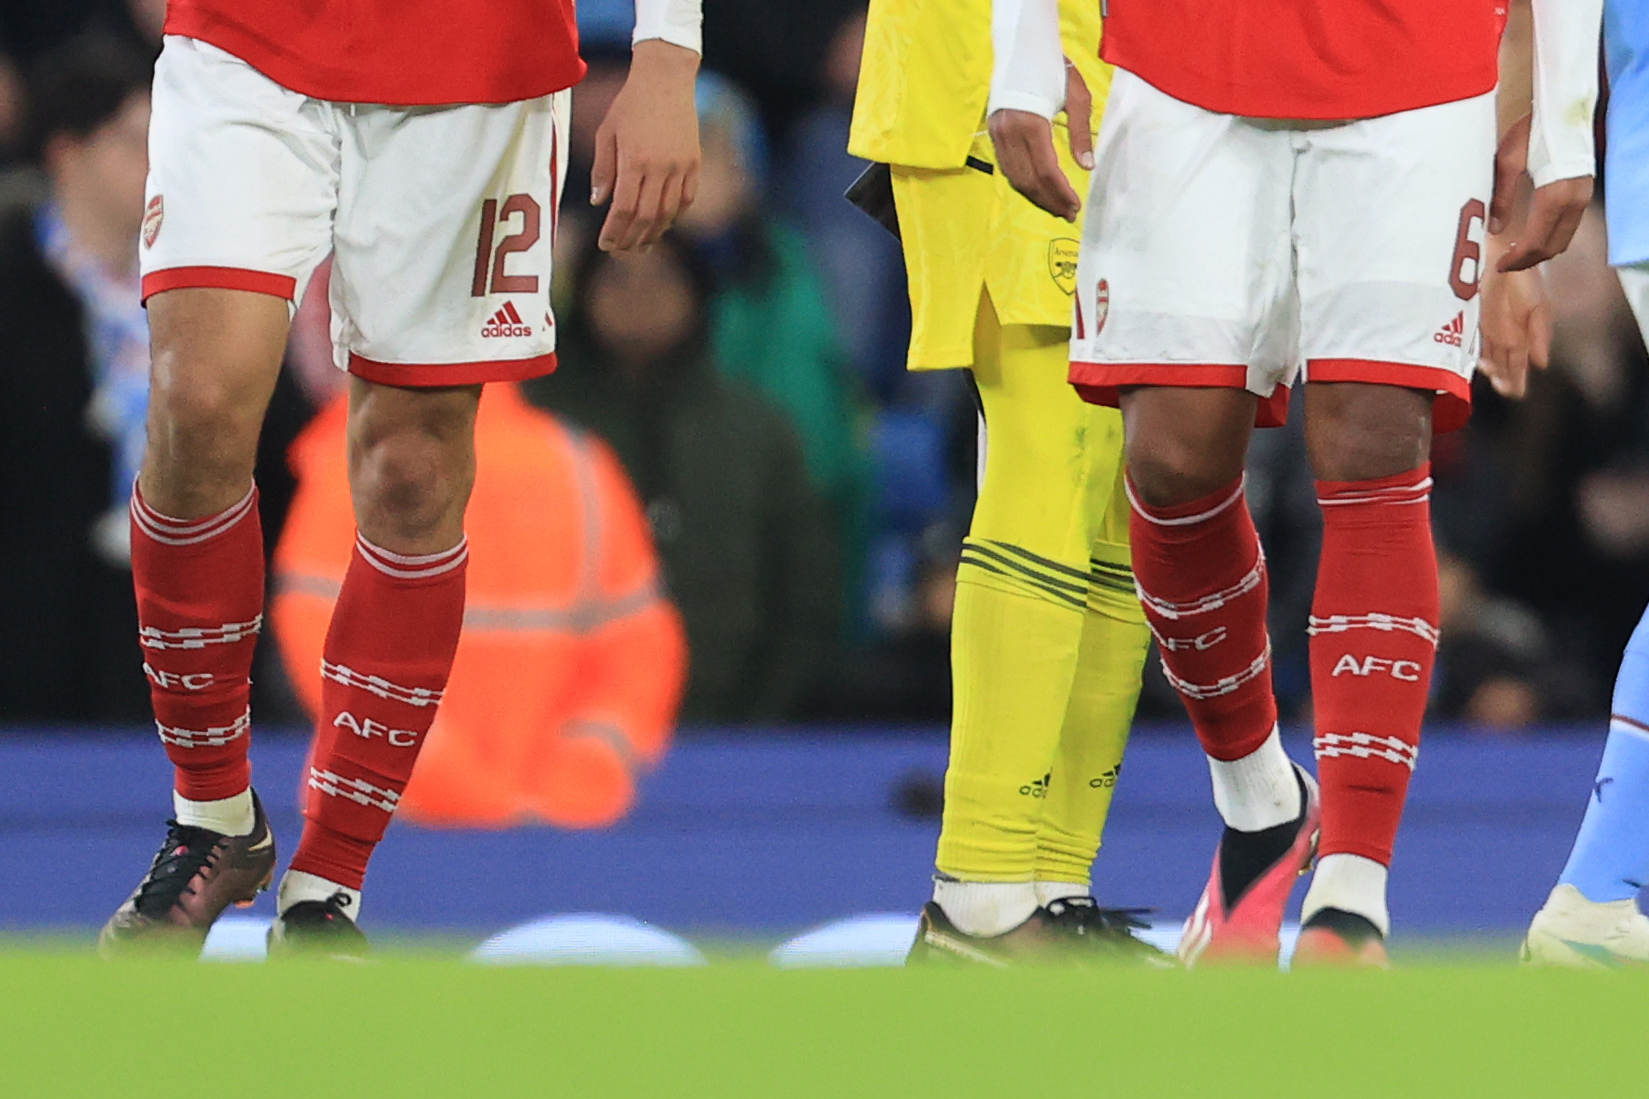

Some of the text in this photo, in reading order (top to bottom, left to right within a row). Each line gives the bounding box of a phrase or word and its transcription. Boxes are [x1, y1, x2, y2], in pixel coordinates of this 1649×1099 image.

[470, 192, 542, 298] 12
[1448, 197, 1486, 302] 6
[481, 322, 533, 338] adidas
[1331, 652, 1422, 682] AFC
[333, 710, 418, 747] AFC
